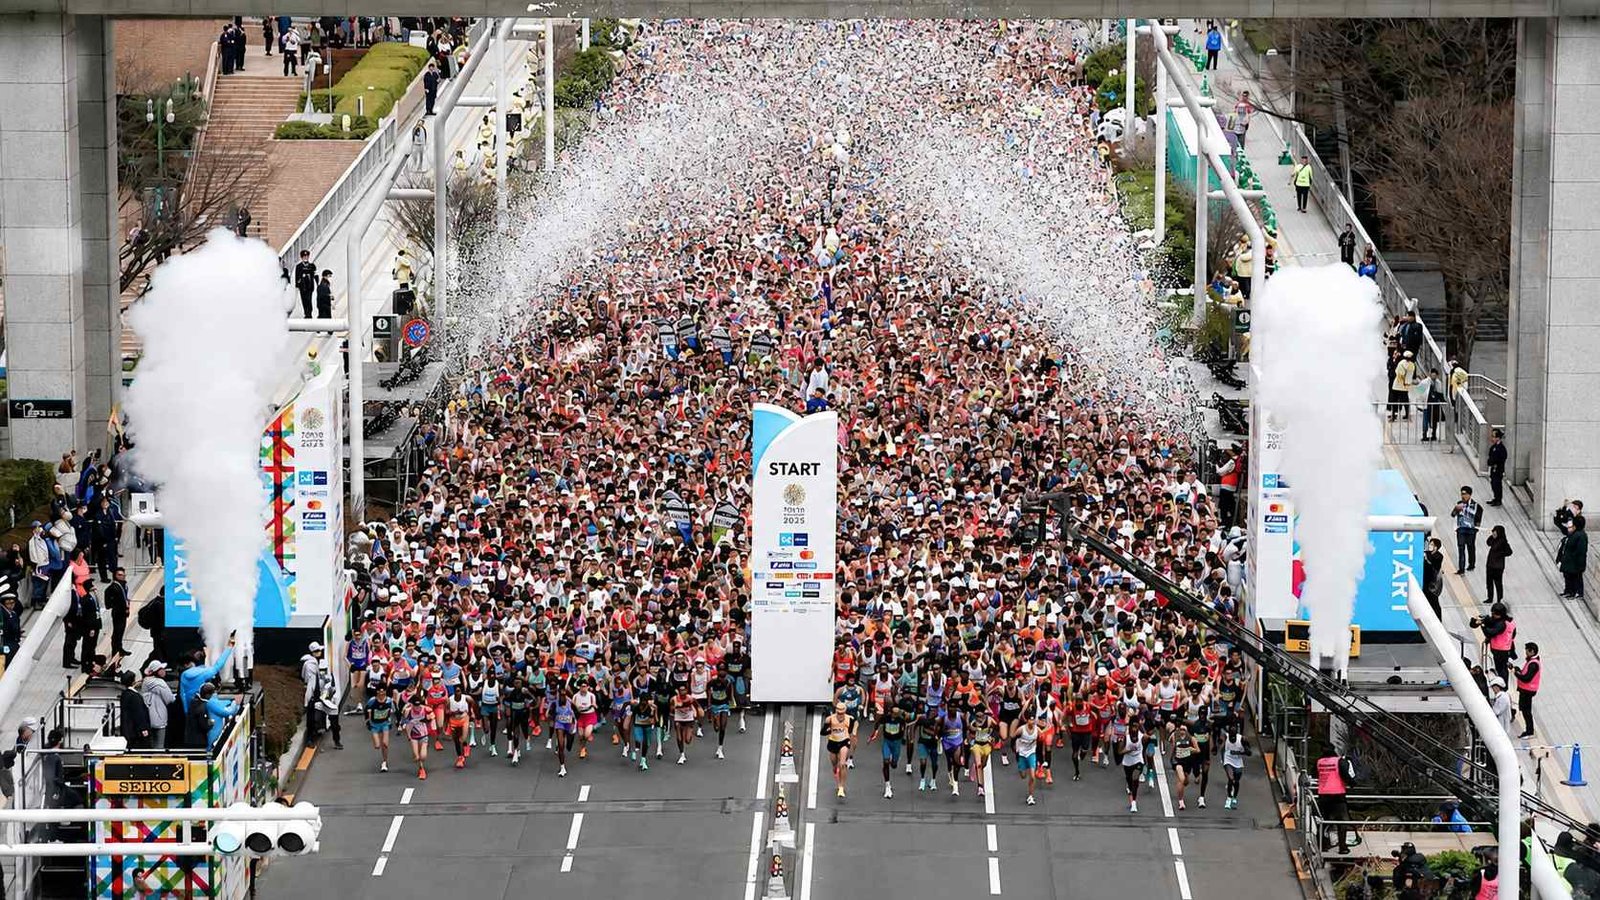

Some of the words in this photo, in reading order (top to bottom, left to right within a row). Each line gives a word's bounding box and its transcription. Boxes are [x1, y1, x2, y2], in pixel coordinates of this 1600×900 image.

[769, 462, 821, 476] START
[783, 517, 805, 525] 2025
[119, 781, 172, 793] SEIKO
